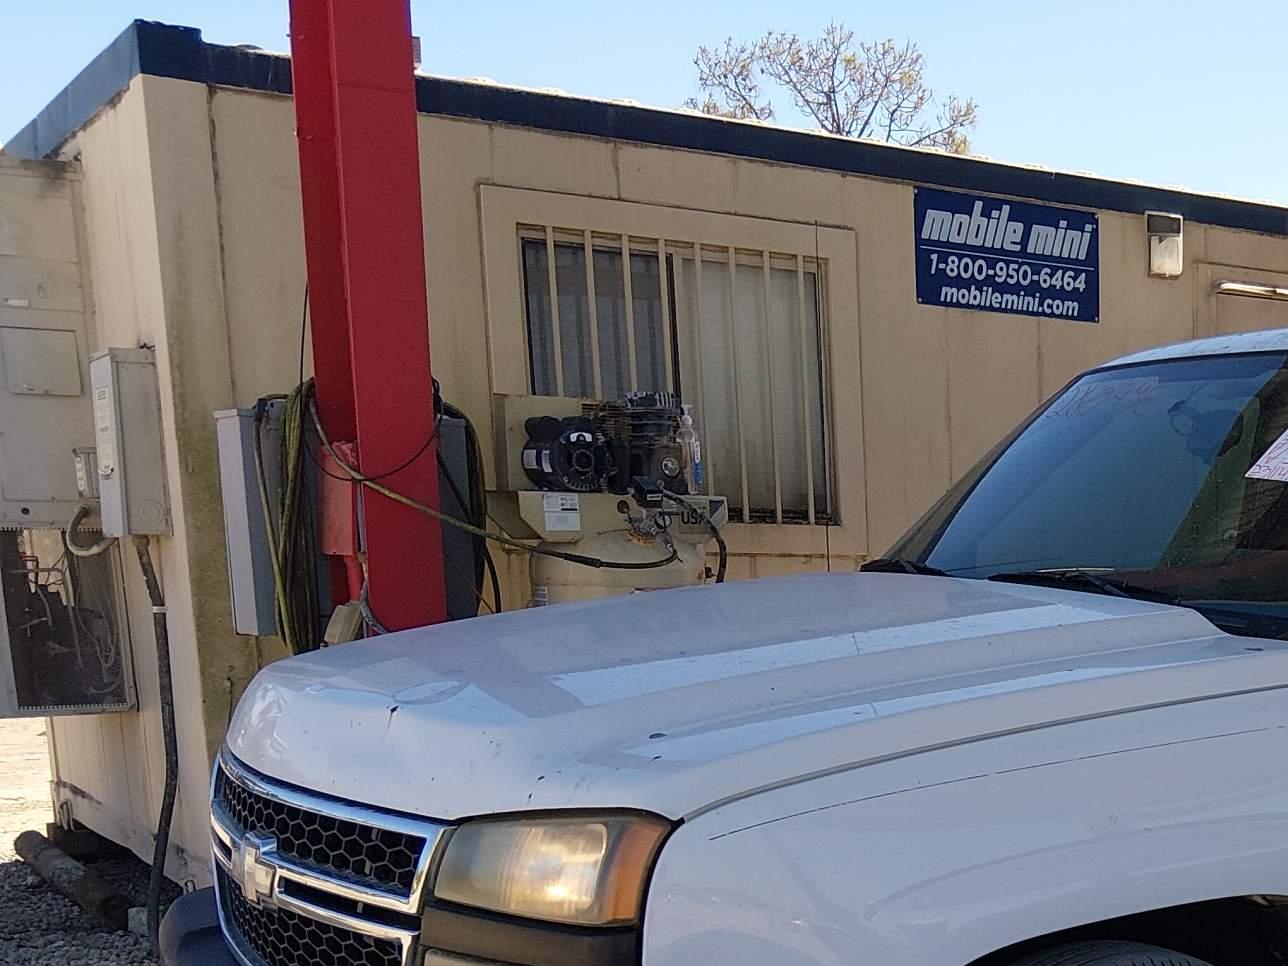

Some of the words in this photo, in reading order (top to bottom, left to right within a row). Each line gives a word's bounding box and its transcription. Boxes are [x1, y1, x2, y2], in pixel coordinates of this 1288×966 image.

[921, 201, 1024, 251] mobile
[1027, 220, 1093, 260] mini
[930, 253, 1086, 293] 1-800-950-6464
[940, 285, 1079, 317] mobilemini.com
